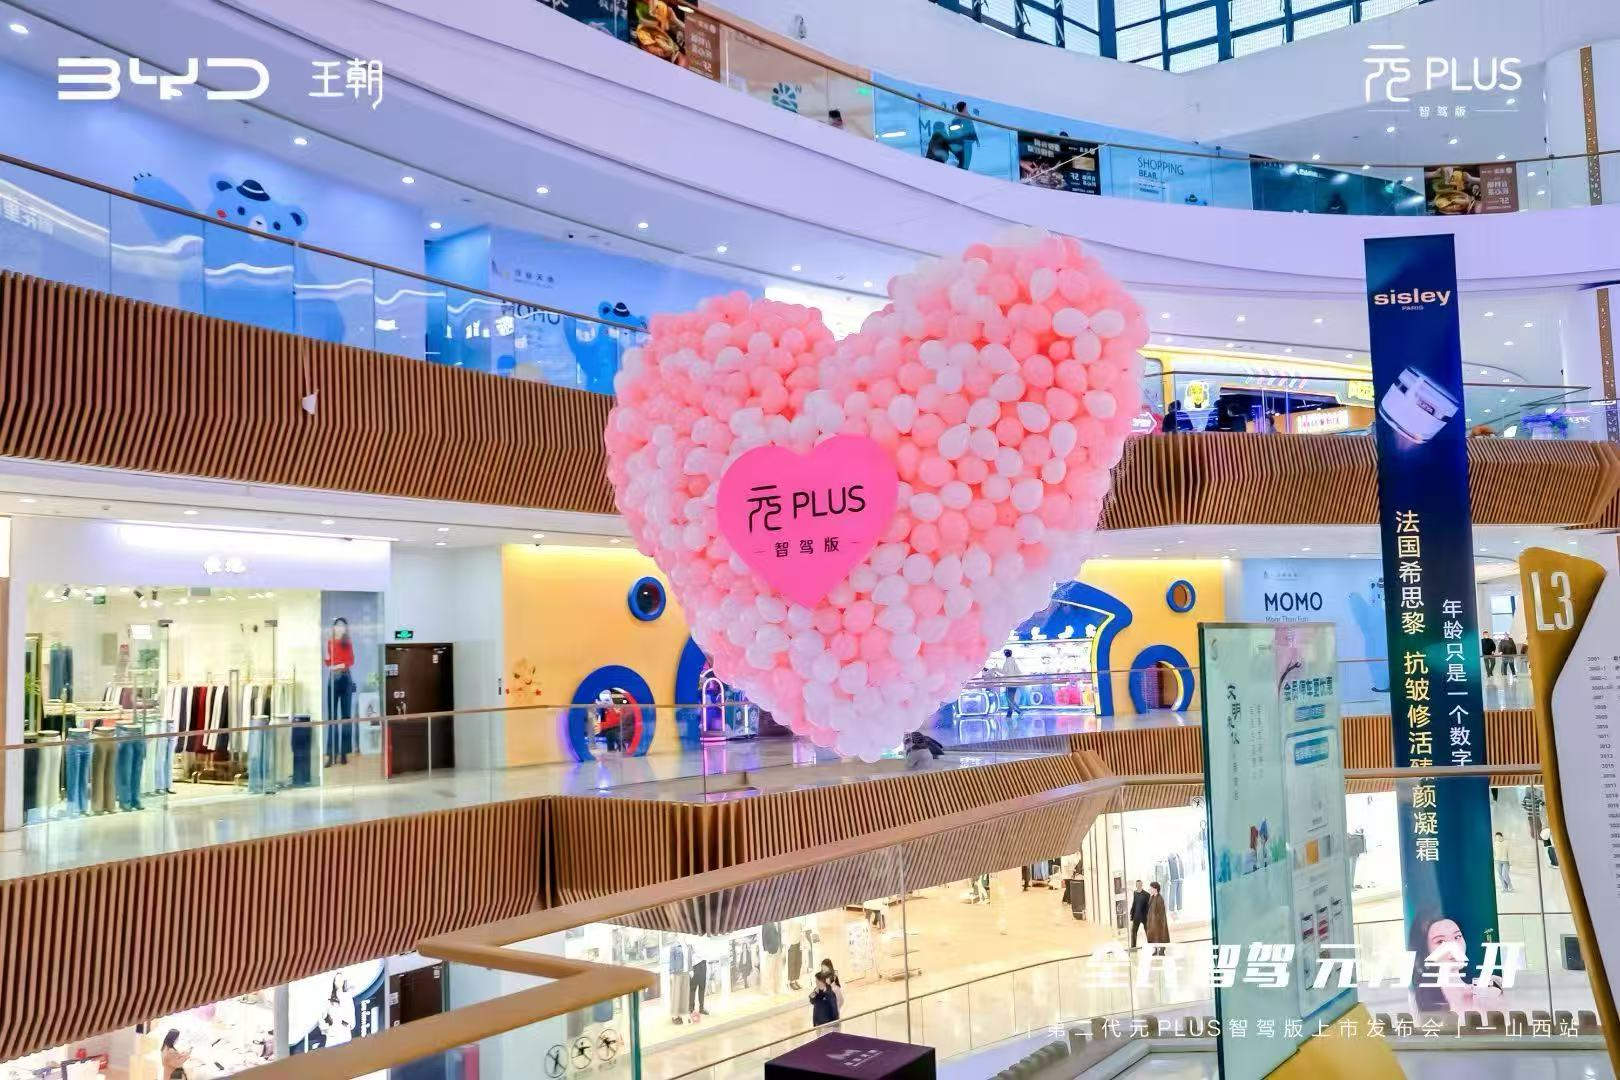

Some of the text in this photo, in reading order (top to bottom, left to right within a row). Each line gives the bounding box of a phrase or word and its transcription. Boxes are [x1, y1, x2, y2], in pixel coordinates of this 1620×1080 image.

[1137, 157, 1185, 176] SHOPPING
[1374, 288, 1451, 306] sisley
[747, 485, 866, 533] 元 PLUS
[775, 536, 840, 558] 智驾版
[1396, 509, 1427, 635] 法国希思黎
[1264, 591, 1323, 611] MOMO
[1530, 571, 1576, 633] L3
[1442, 599, 1474, 767] 年龄只是一个数字
